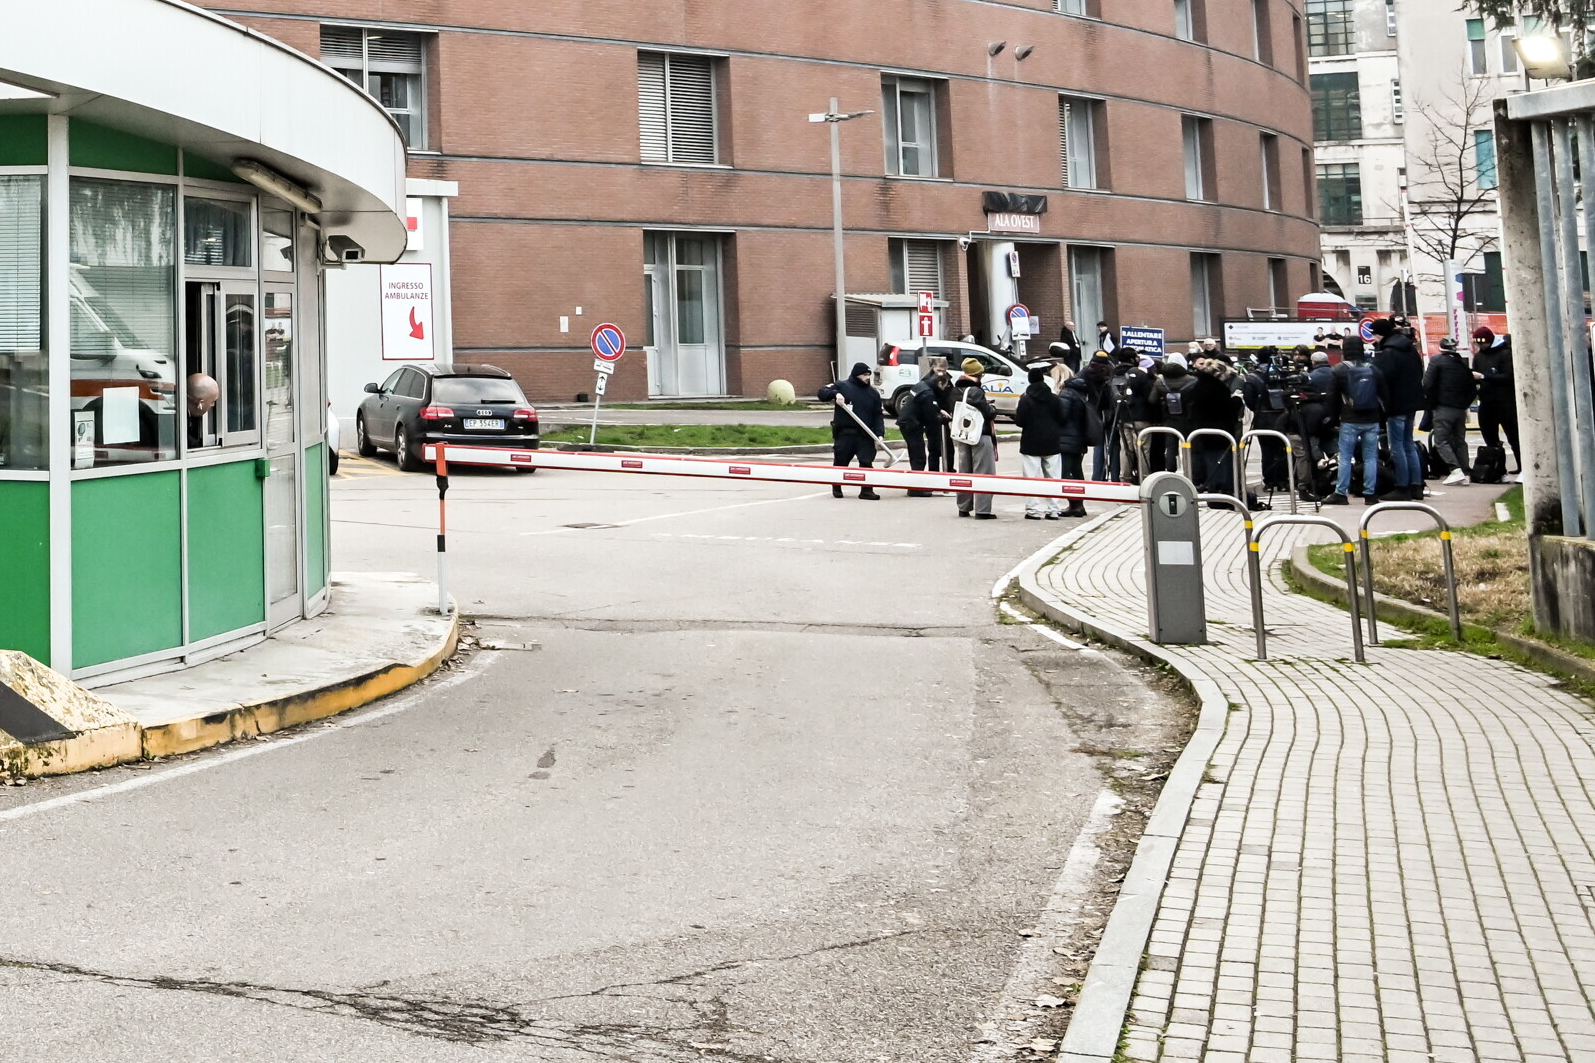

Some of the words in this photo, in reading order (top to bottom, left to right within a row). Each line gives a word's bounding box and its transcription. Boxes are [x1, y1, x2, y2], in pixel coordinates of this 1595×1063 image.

[996, 214, 1010, 227] ALA
[1011, 214, 1035, 228] OVEST
[1358, 274, 1371, 284] 16
[1122, 331, 1162, 339] RALLENTARE
